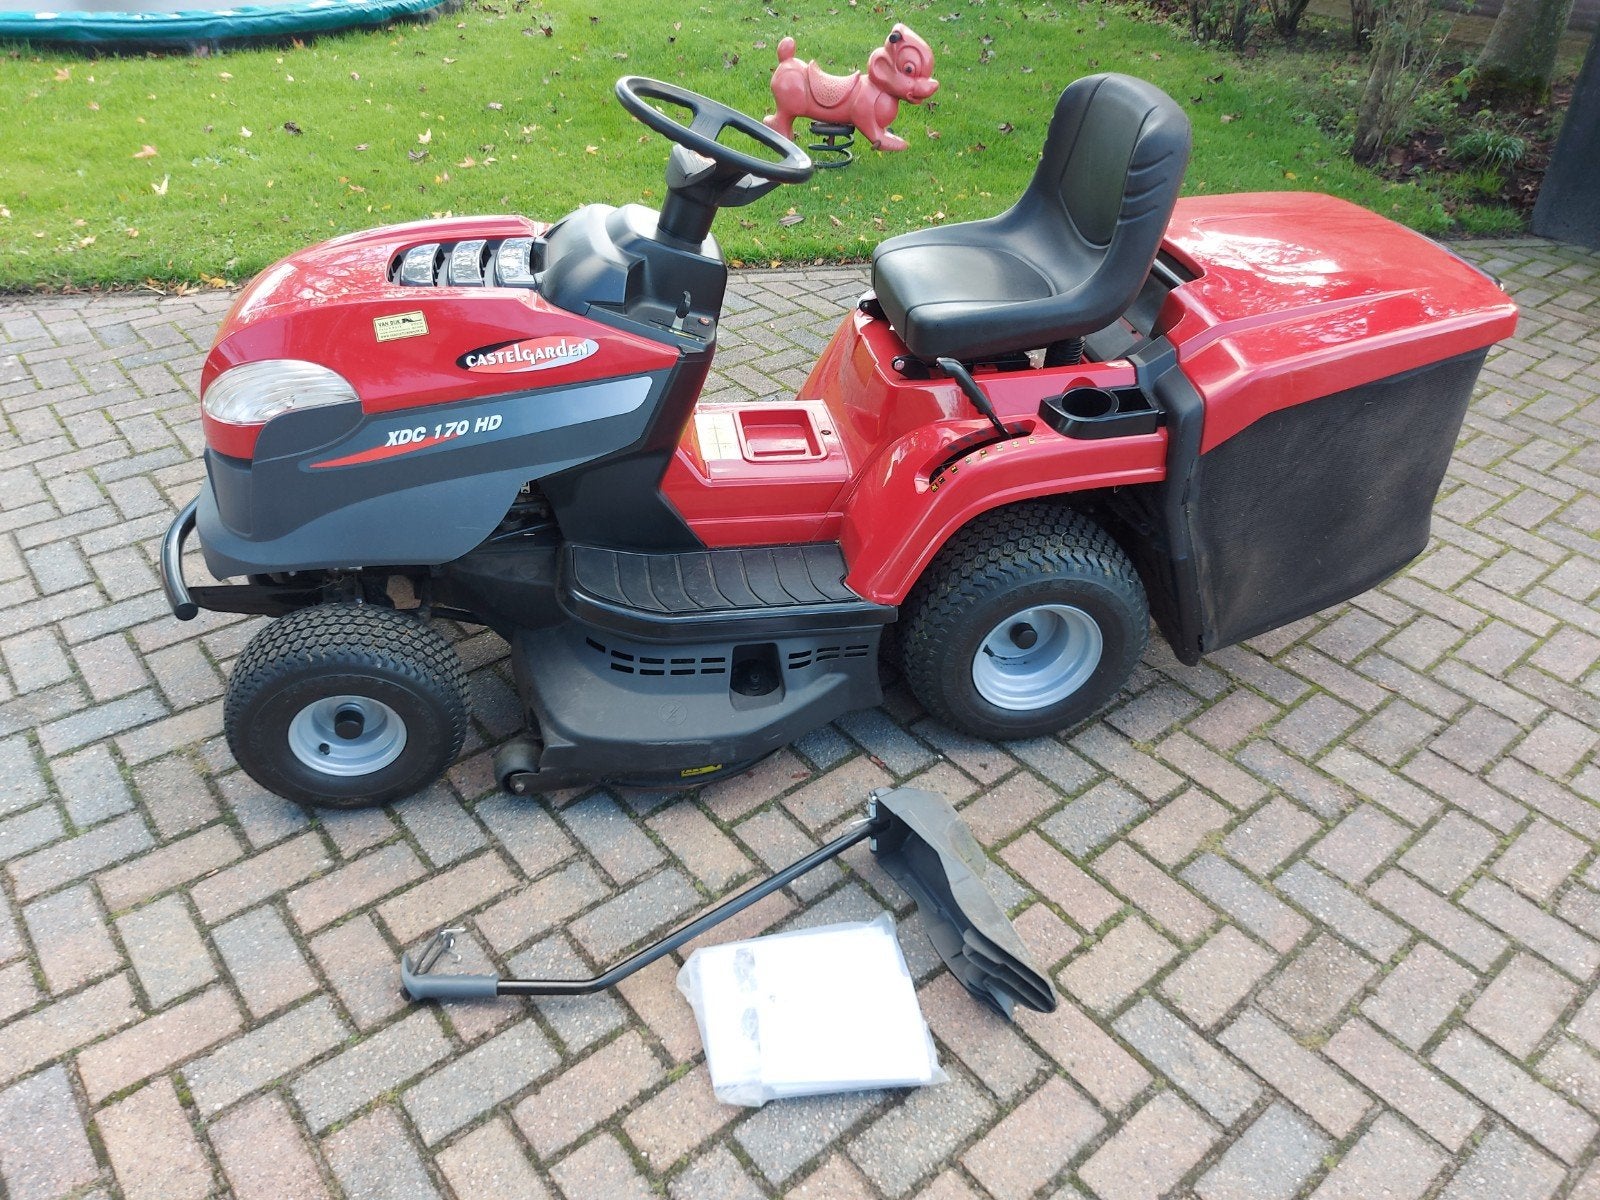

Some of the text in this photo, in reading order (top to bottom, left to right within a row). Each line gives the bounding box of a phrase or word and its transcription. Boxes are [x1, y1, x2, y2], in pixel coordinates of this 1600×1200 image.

[384, 414, 503, 447] XDC 170 HD
